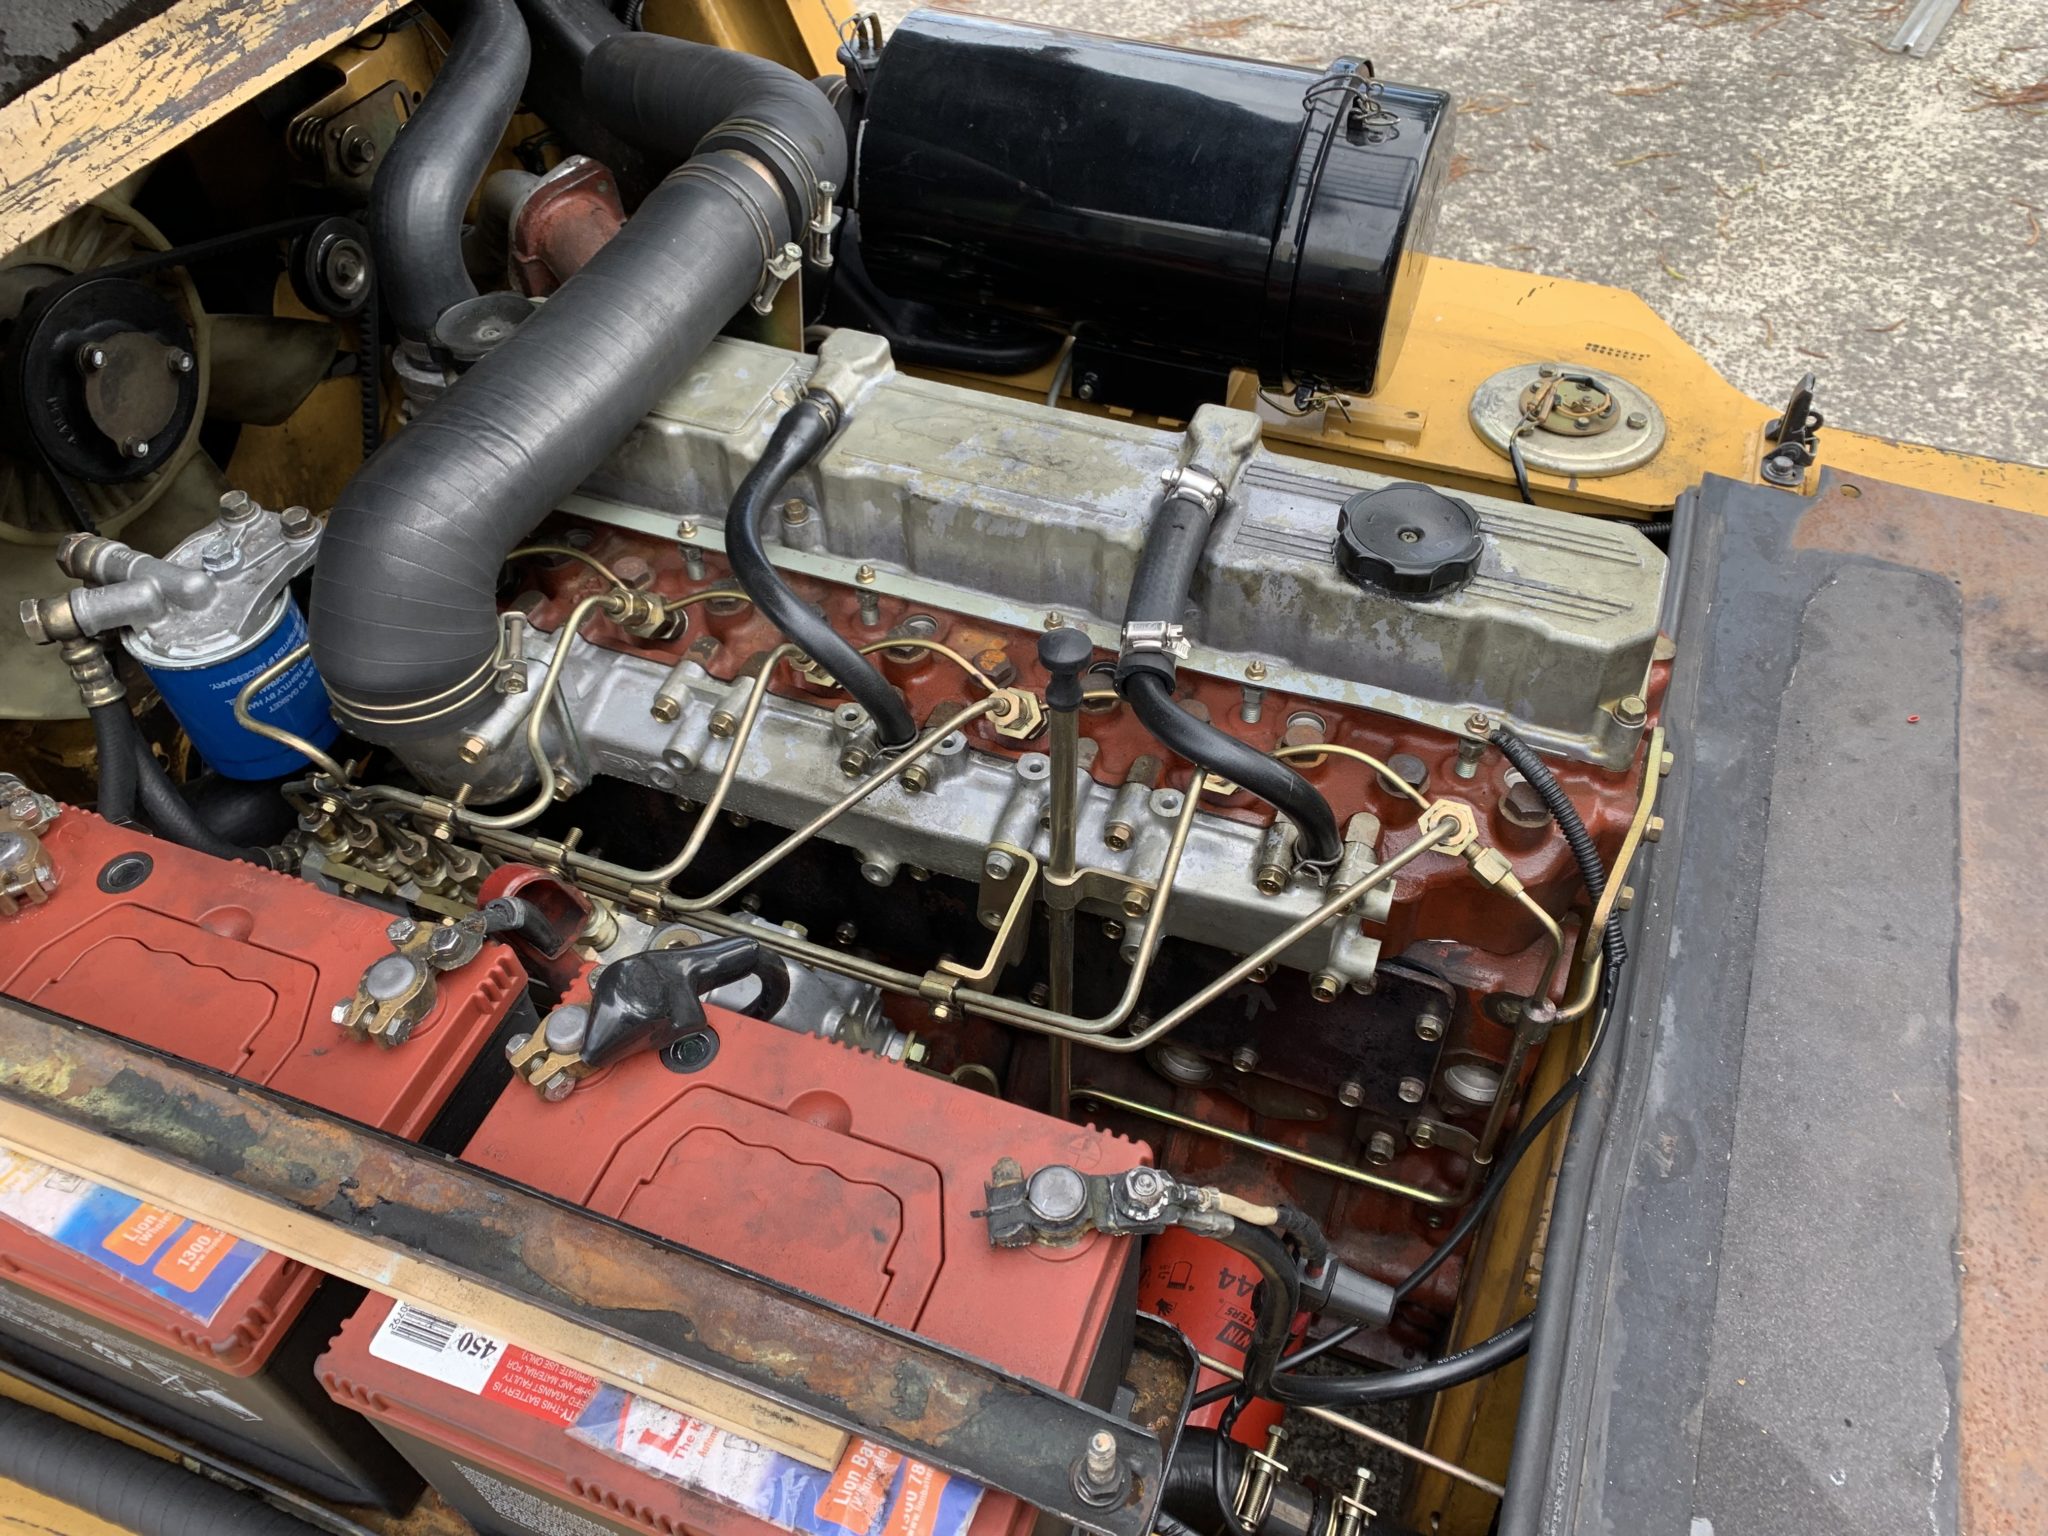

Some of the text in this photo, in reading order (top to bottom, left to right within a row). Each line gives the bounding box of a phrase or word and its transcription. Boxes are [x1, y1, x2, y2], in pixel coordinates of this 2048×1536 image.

[299, 678, 308, 690] TO
[265, 692, 276, 704] BY
[269, 688, 299, 713] GASKET
[122, 1214, 157, 1242] Lion
[177, 1235, 211, 1267] 1300
[1225, 1306, 1257, 1330] LTERS
[457, 1332, 497, 1360] 450
[506, 1359, 523, 1372] FOR
[523, 1365, 559, 1386] MATERIAL
[544, 1359, 559, 1372] USE
[492, 1381, 502, 1392] IS
[502, 1372, 534, 1390] FAULTY
[502, 1386, 540, 1407] BATTERY
[533, 1383, 569, 1402] AGAINST
[672, 1435, 696, 1460] The
[833, 1470, 862, 1505] Lion
